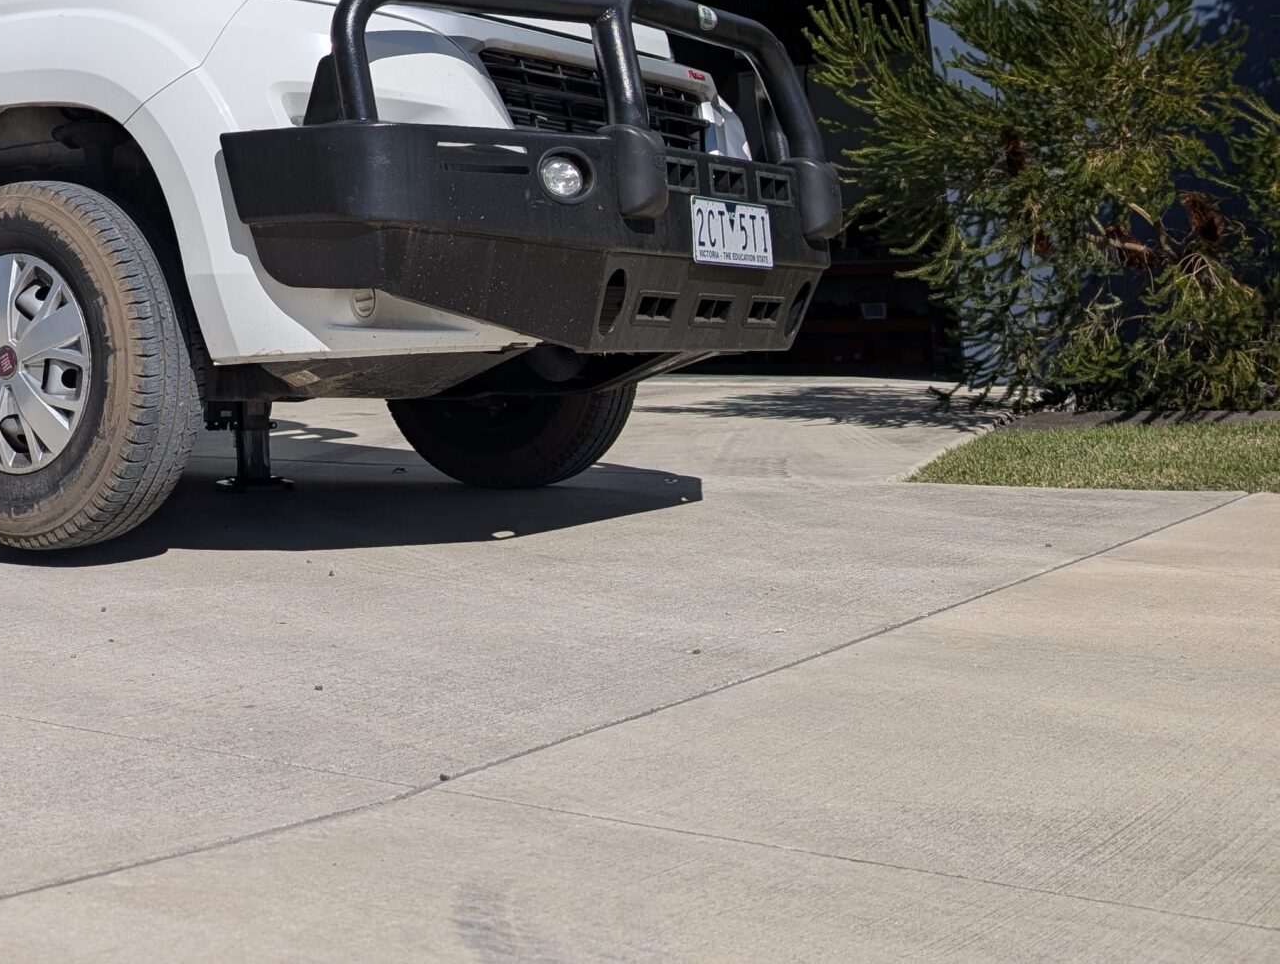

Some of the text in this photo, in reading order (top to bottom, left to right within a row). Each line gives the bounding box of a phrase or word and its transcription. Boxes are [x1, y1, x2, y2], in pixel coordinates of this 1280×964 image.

[696, 207, 726, 249] 2CT
[700, 250, 719, 259] VICTORIA
[723, 251, 732, 261] THE
[733, 253, 756, 262] EDUCATION
[757, 254, 769, 264] STATE
[0, 352, 13, 372] FIAT
